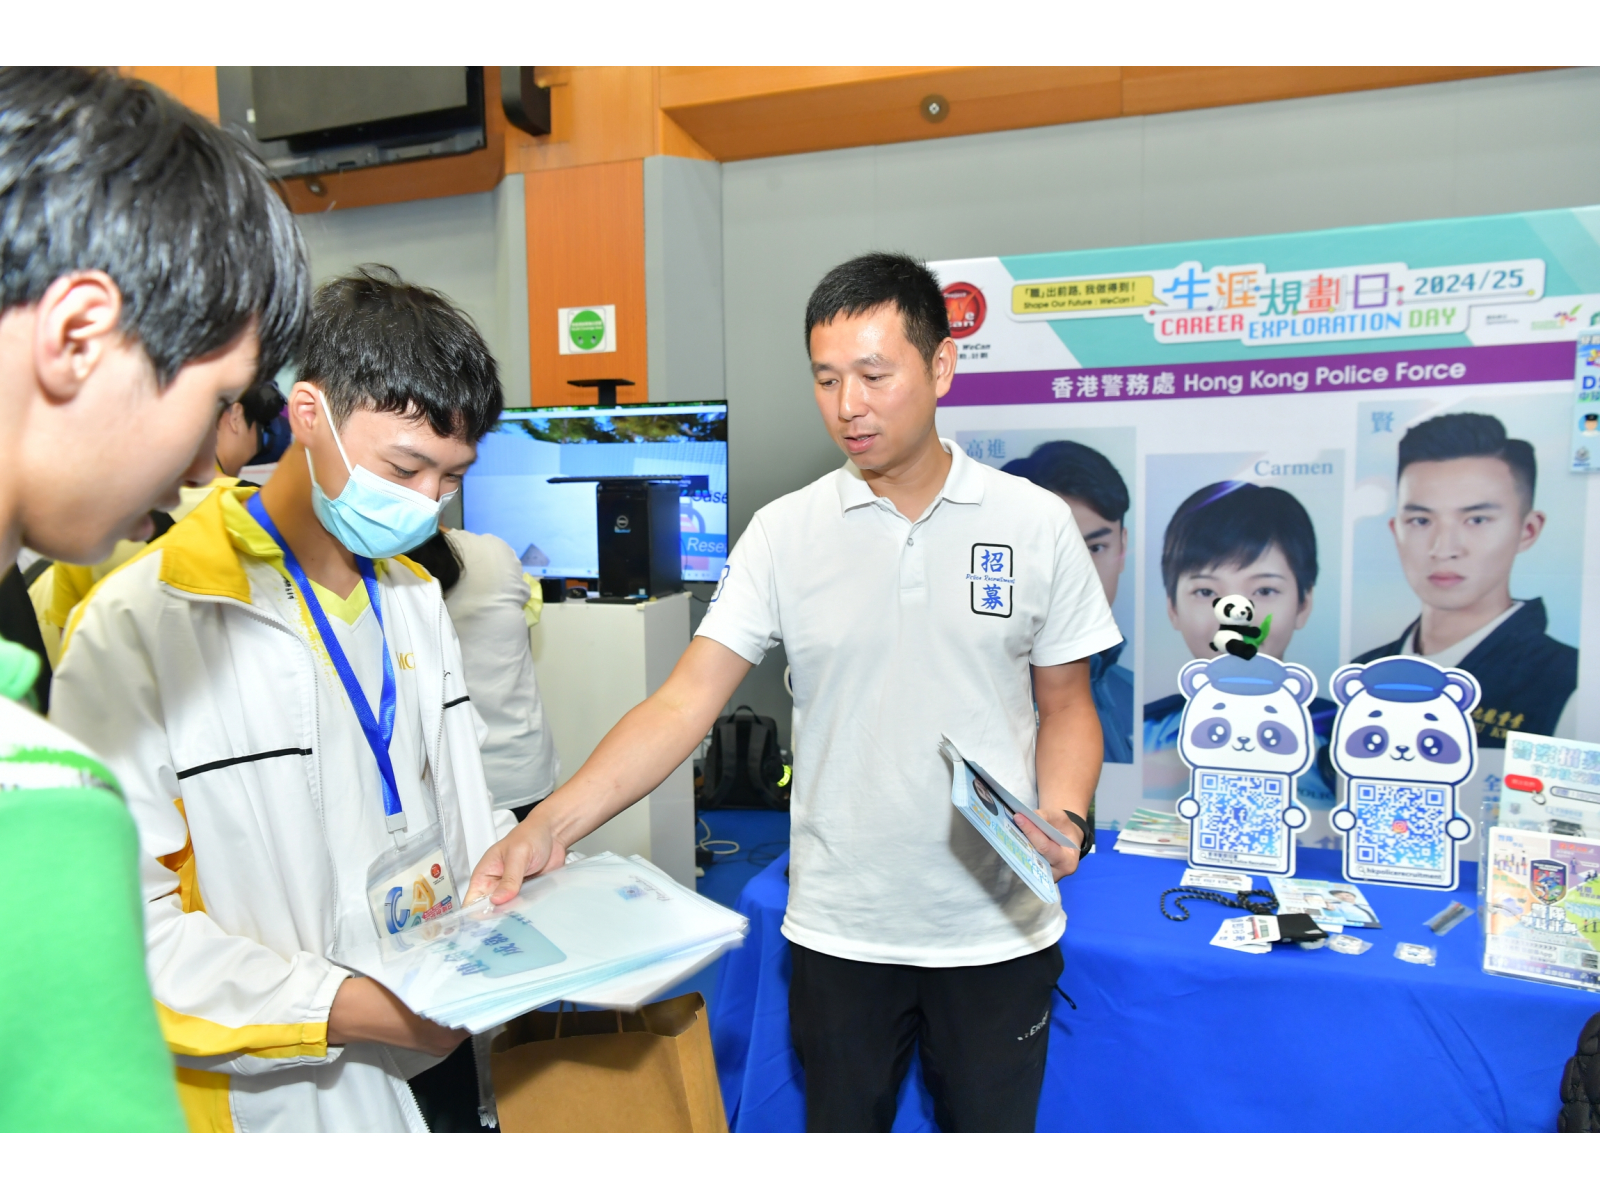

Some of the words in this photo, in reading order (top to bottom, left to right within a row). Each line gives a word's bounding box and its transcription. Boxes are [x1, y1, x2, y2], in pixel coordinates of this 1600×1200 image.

[1414, 268, 1524, 296] 2024/25
[1024, 300, 1049, 310] Shape
[1051, 299, 1066, 308] Our
[1068, 298, 1093, 307] Future
[1161, 314, 1244, 336] CAREER
[1249, 311, 1402, 339] EXPLORATION
[1409, 306, 1456, 329] DAY
[1052, 371, 1175, 399] 香港警務處
[1184, 373, 1243, 394] Hong
[1250, 369, 1309, 391] Kong
[1315, 364, 1389, 386] Police
[1396, 361, 1466, 381] Force
[965, 438, 1006, 460] 高進
[1254, 459, 1334, 477] Carmen
[965, 573, 982, 581] Police
[984, 574, 1016, 584] Recruitment
[1366, 867, 1442, 880] hkpolicerecruitment
